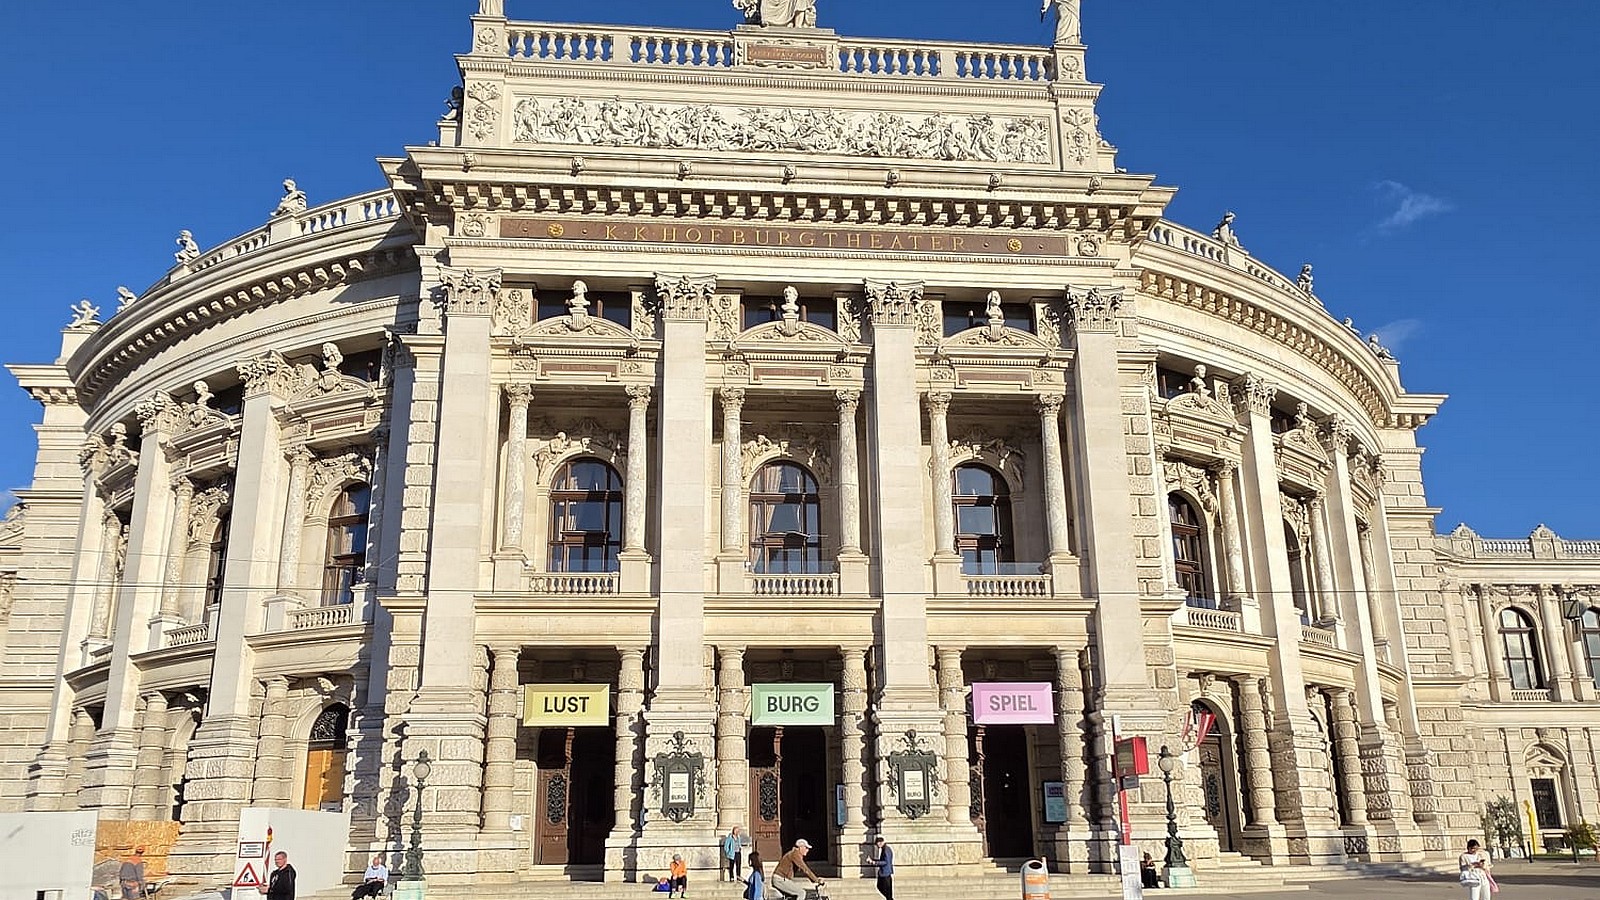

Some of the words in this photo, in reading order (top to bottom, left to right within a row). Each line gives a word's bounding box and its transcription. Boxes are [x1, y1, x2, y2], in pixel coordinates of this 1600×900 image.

[662, 226, 966, 251] HOFBURGTHEATER
[544, 696, 590, 713] LUST
[767, 695, 820, 712] BURG
[989, 694, 1037, 711] SPIEL
